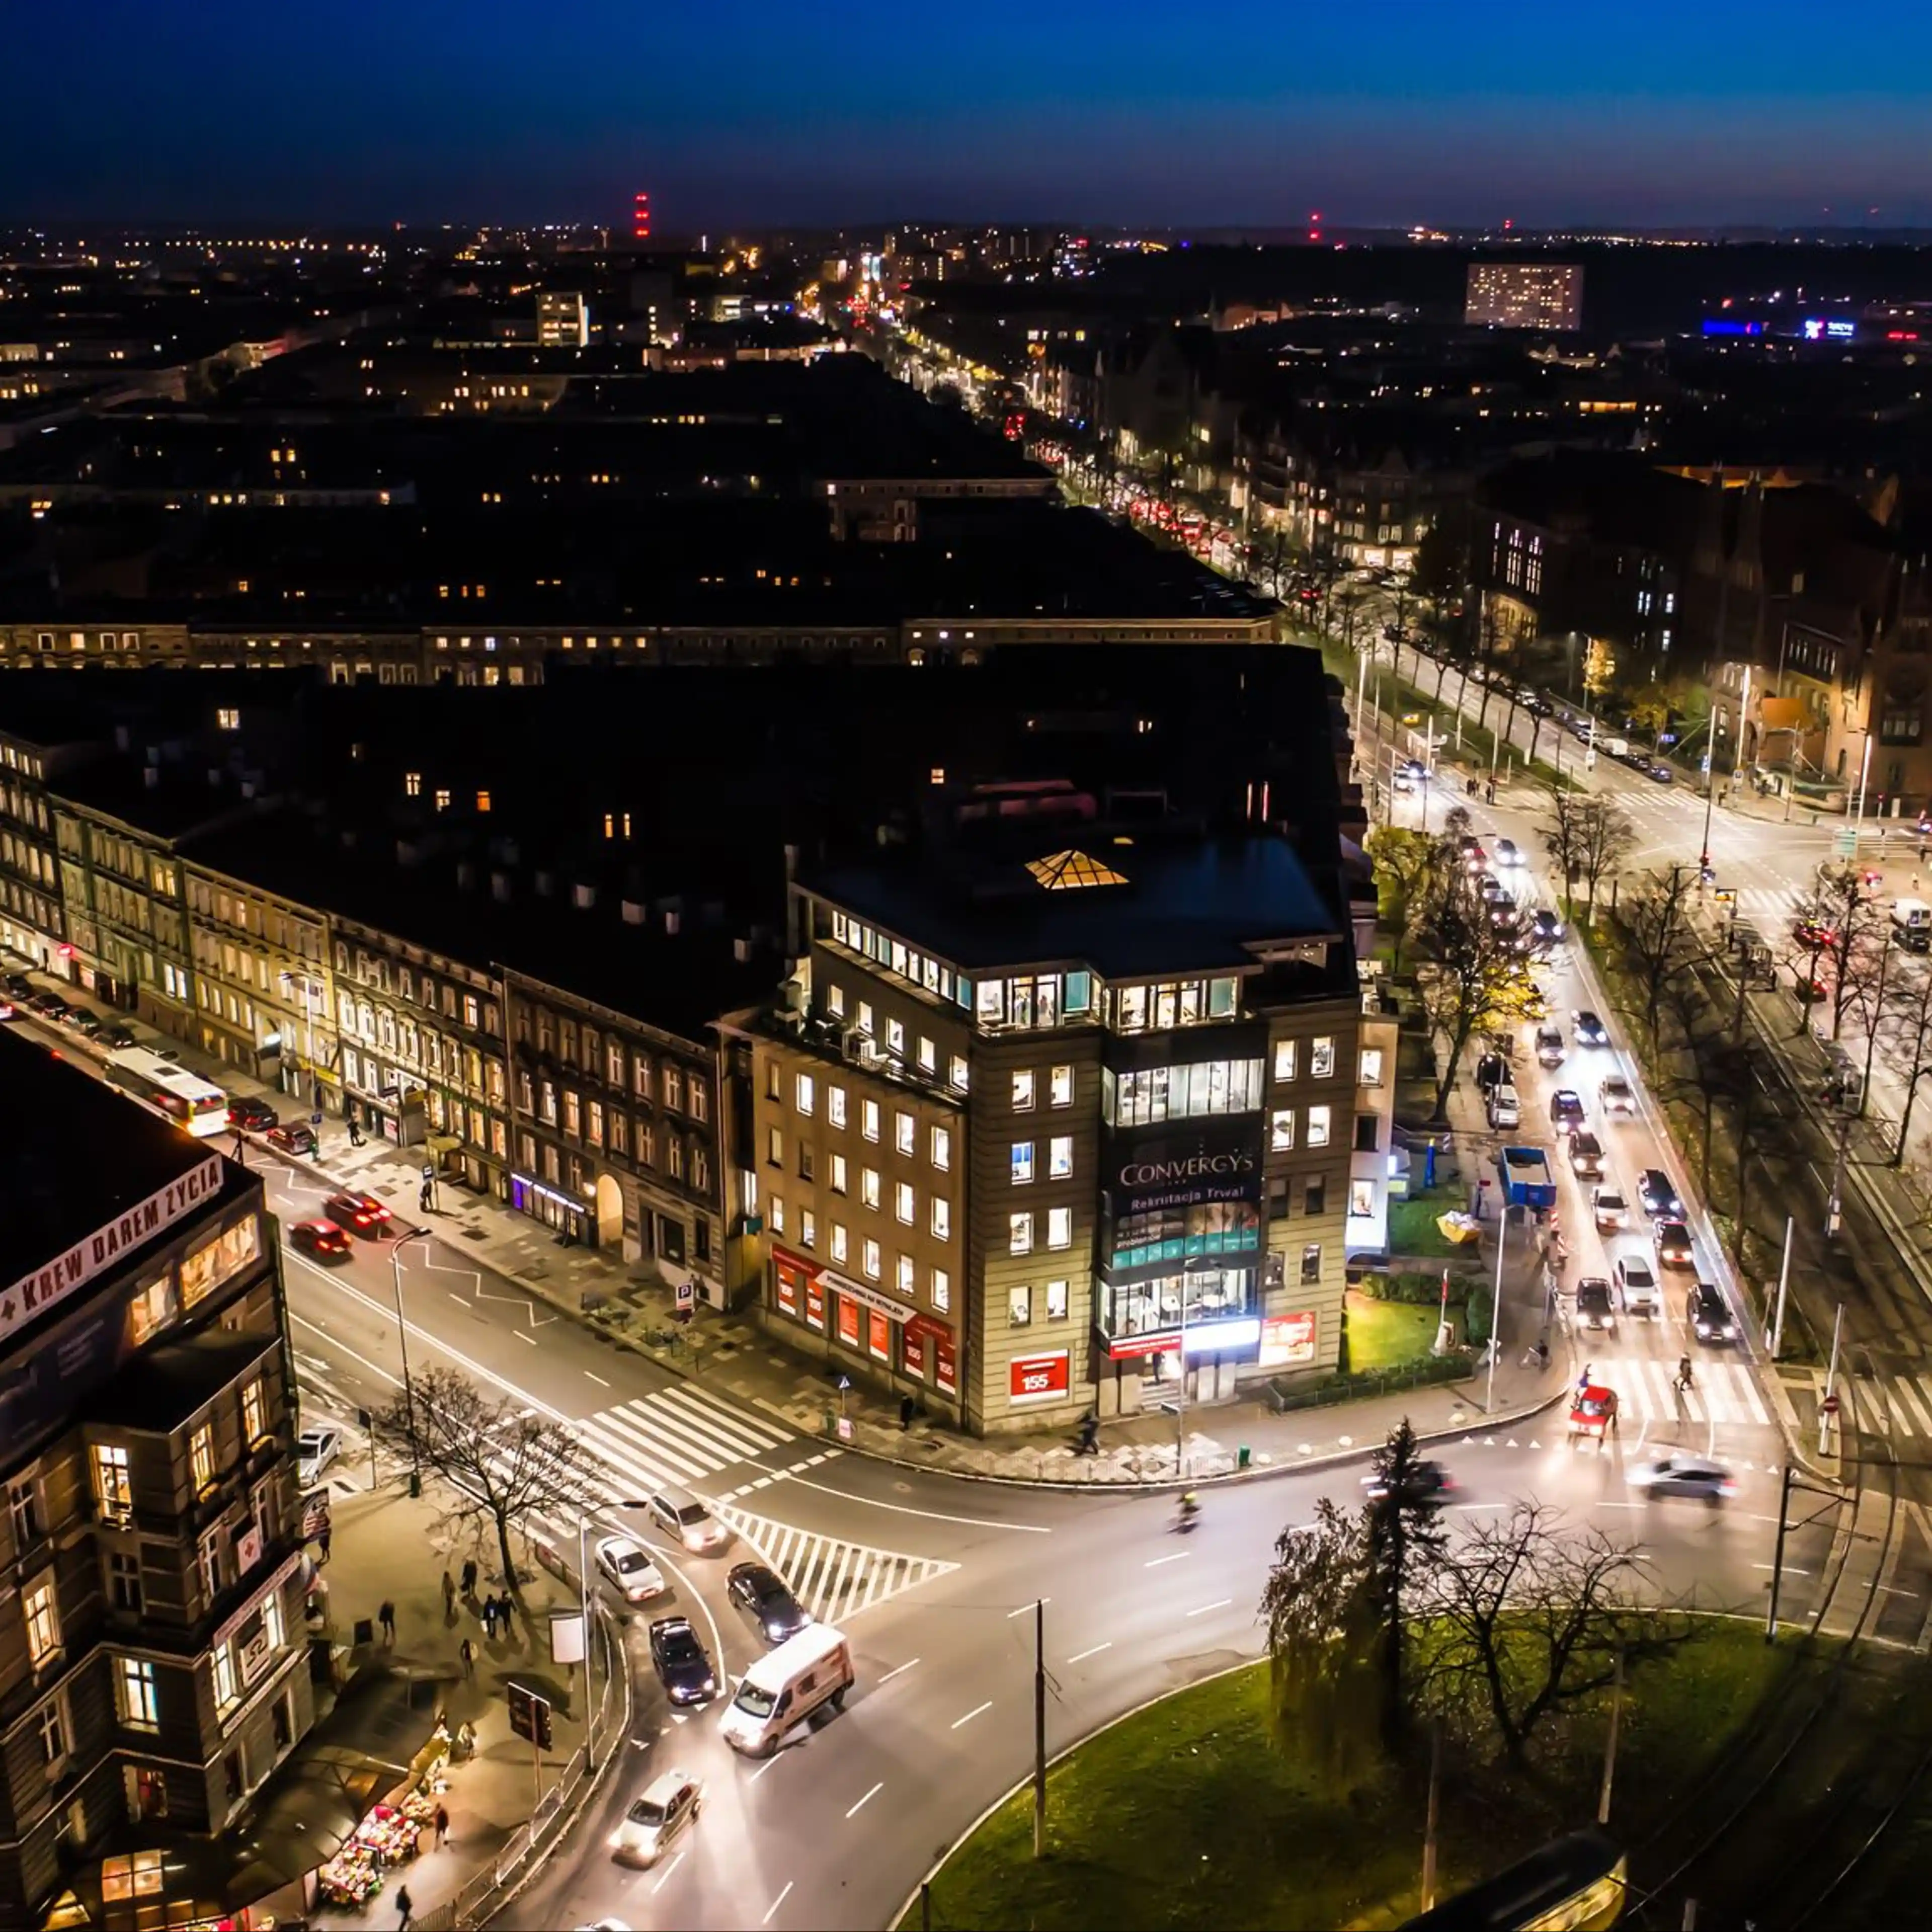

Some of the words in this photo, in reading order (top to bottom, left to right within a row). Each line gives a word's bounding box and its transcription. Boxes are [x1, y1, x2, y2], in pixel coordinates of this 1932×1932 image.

[1120, 1154, 1253, 1186] CONVERGYS
[22, 1250, 82, 1311] KREW
[92, 1199, 158, 1264] DAREM
[1021, 1374, 1049, 1391] 155
